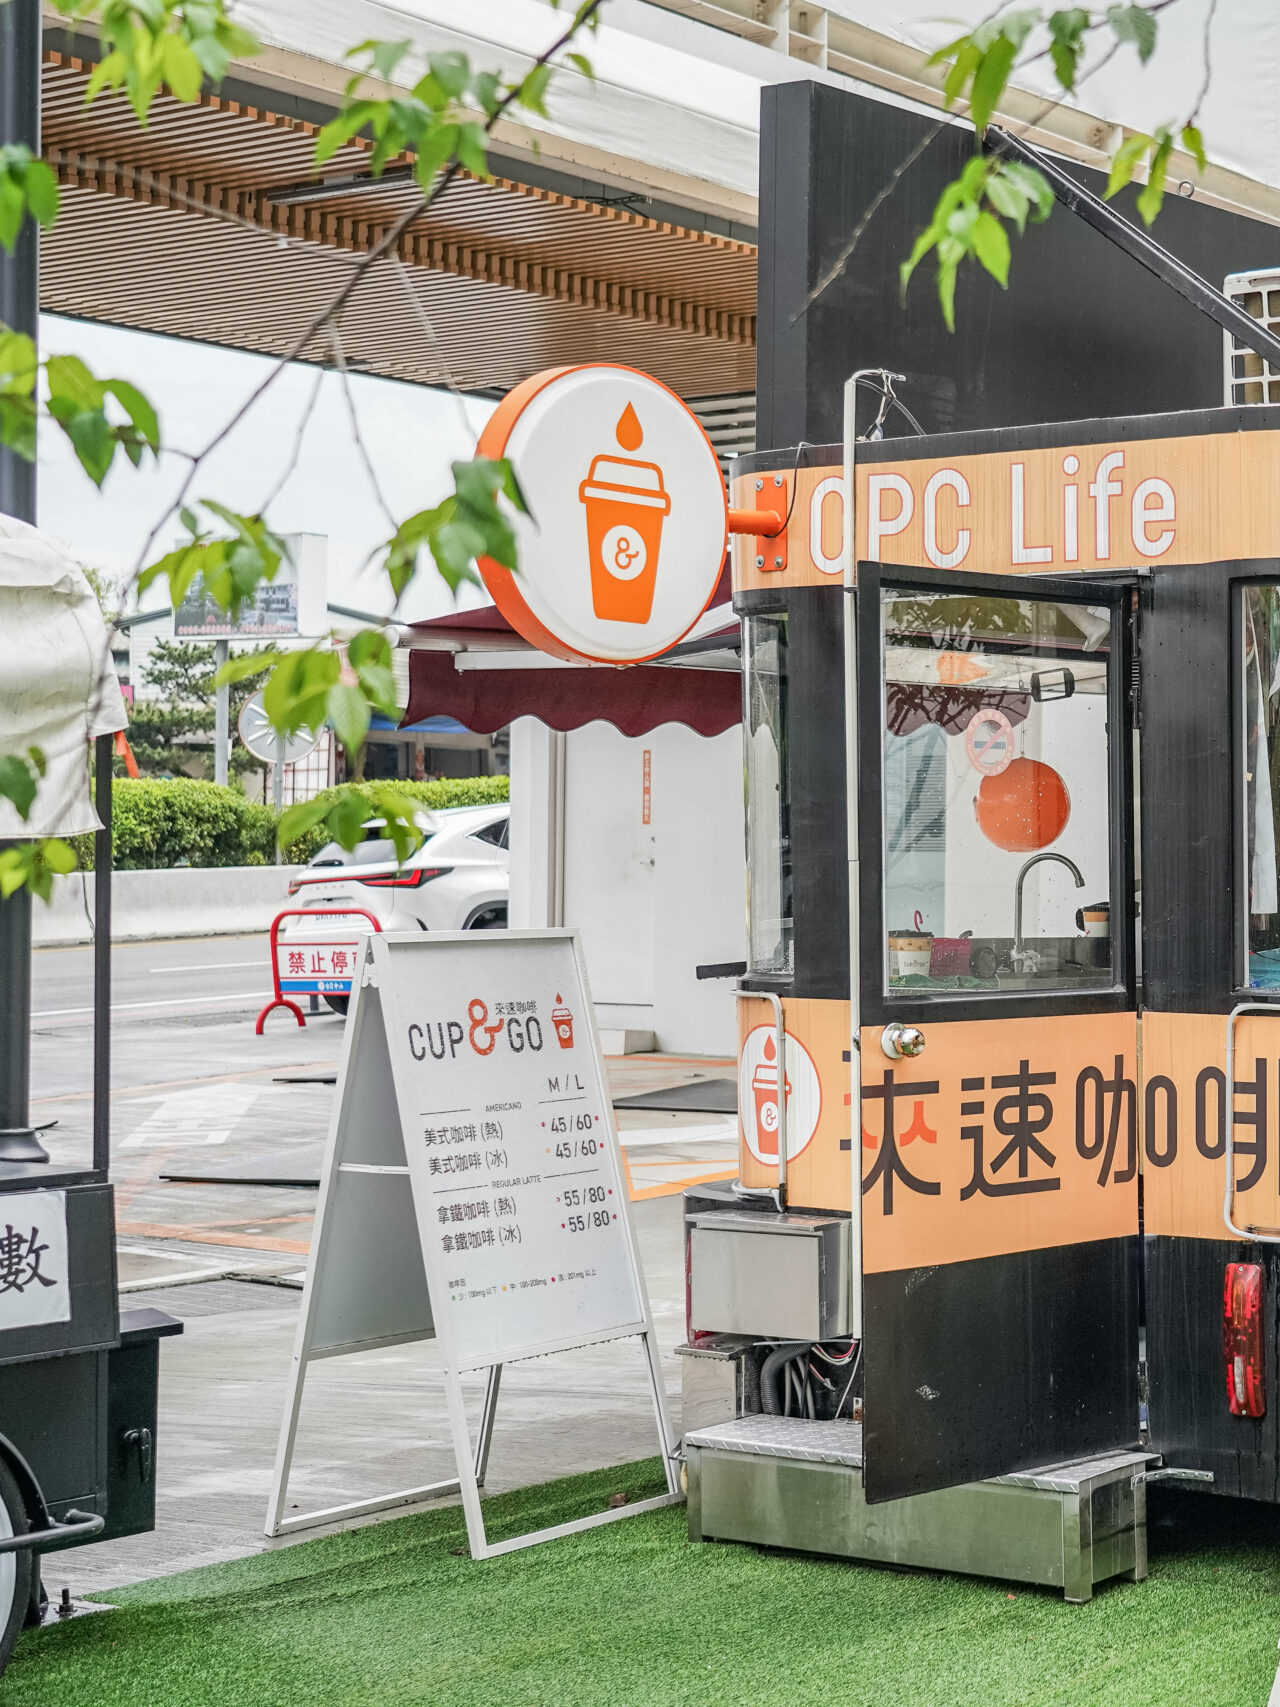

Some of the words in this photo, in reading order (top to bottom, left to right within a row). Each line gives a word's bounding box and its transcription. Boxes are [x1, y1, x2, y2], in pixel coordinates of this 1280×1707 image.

[1010, 450, 1177, 565] Life
[614, 536, 640, 570] &
[485, 1101, 522, 1112] AMERICANO
[424, 1123, 477, 1147] 美式咖啡
[429, 1152, 482, 1175] 美式咖啡
[492, 1177, 521, 1189] REGULAR
[522, 1174, 542, 1186] LATTE
[436, 1200, 490, 1225] 拿鐵咖啡
[441, 1227, 495, 1254] 拿鐵咖啡
[0, 1223, 58, 1294] 數
